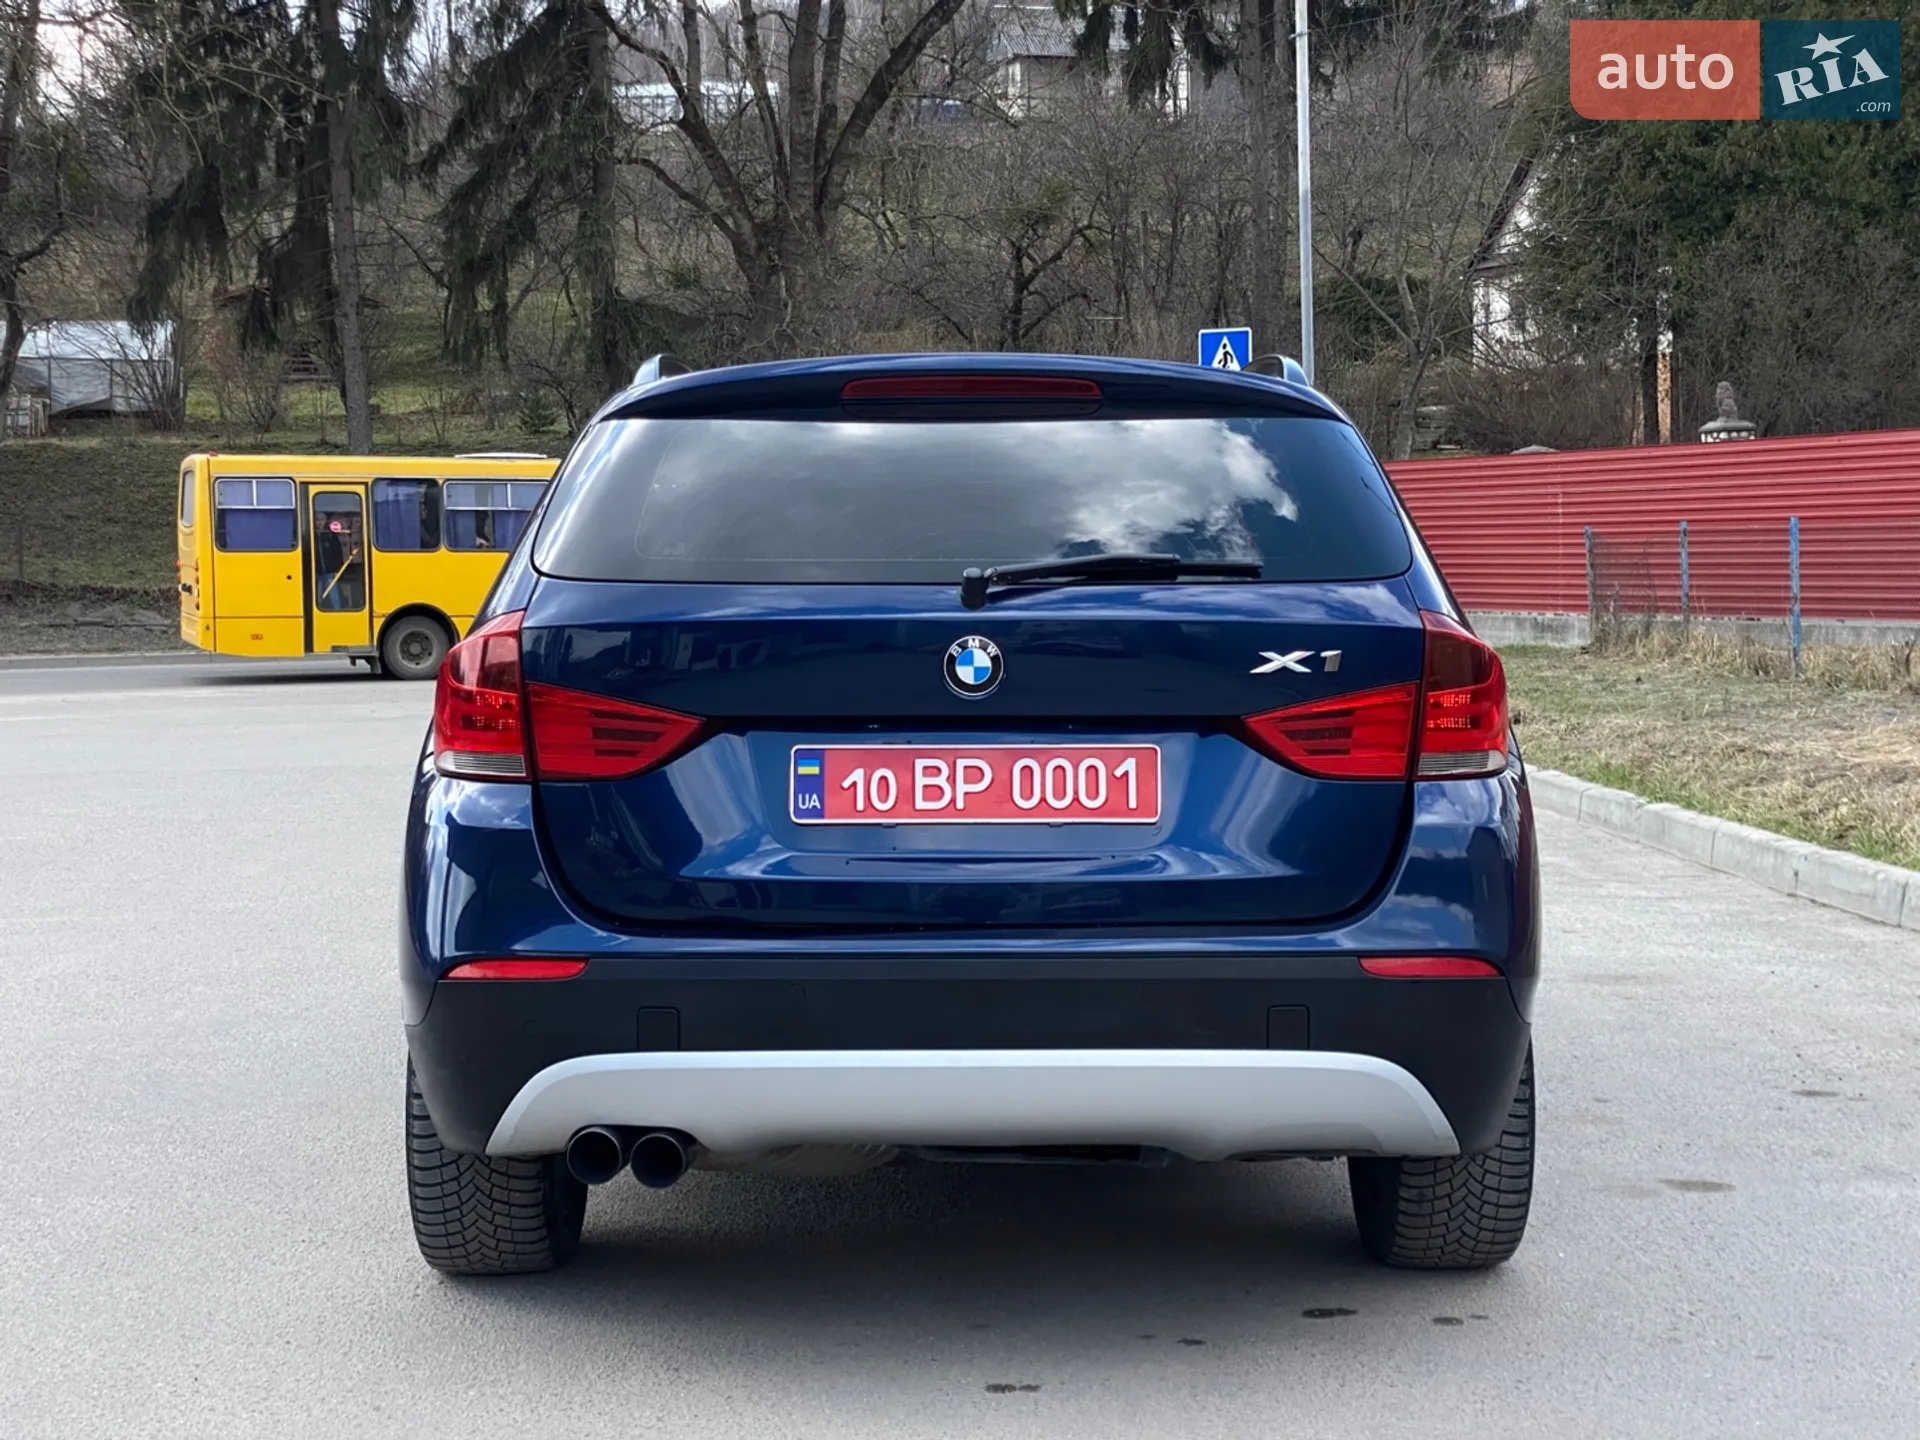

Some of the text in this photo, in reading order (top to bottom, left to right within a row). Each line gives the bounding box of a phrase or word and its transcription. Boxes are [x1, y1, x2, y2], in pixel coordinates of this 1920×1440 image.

[950, 638, 999, 658] BMW
[1249, 650, 1342, 673] X1
[841, 757, 1138, 812] 10 BP 0001
[798, 794, 821, 809] UA
